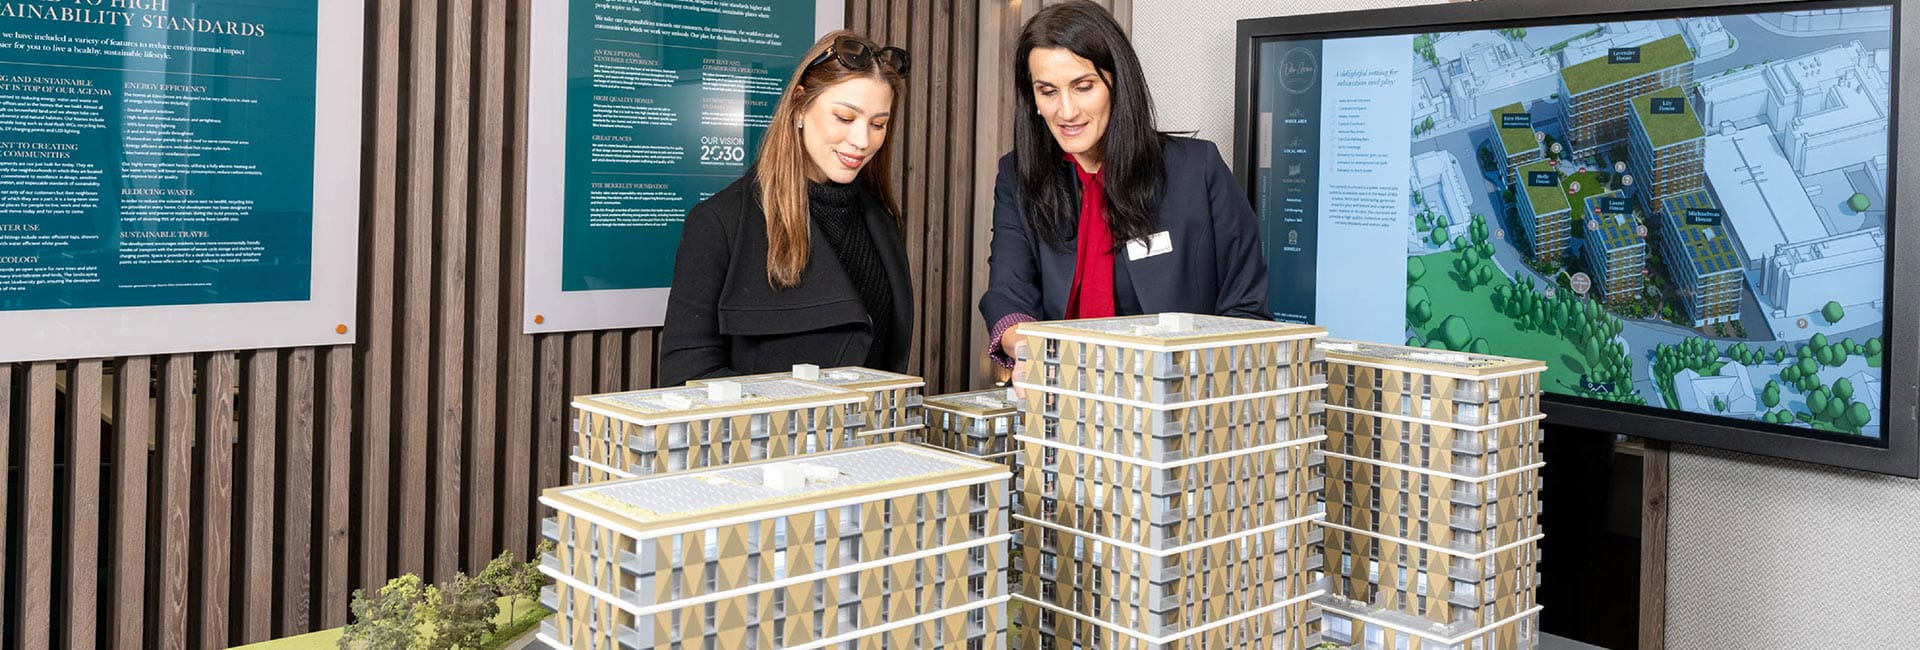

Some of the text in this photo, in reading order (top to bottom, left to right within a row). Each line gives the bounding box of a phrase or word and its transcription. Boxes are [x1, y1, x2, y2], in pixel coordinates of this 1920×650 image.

[0, 2, 265, 37] AINABILITY STANDARDS
[3, 31, 14, 39] we
[15, 31, 33, 40] have
[34, 33, 66, 42] included
[74, 38, 98, 46] variety
[110, 39, 139, 48] features
[149, 42, 172, 50] reduce
[173, 44, 221, 54] environmental
[222, 47, 245, 56] impact
[14, 42, 26, 50] for
[52, 44, 66, 52] live
[74, 46, 103, 56] healthy,
[104, 48, 142, 57] sustainable
[144, 50, 172, 60] lifestyle.
[11, 75, 32, 83] AND
[33, 76, 94, 87] SUSTAINABLE
[76, 88, 112, 96] AGENDA
[124, 82, 208, 93] ENERGY EFFICIENCY
[700, 136, 744, 146] OUR VISION
[32, 142, 78, 151] CREATING
[4, 150, 70, 159] COMMUNITIES
[700, 145, 745, 162] 2030
[23, 224, 40, 232] USE
[178, 230, 210, 238] TRAVEL
